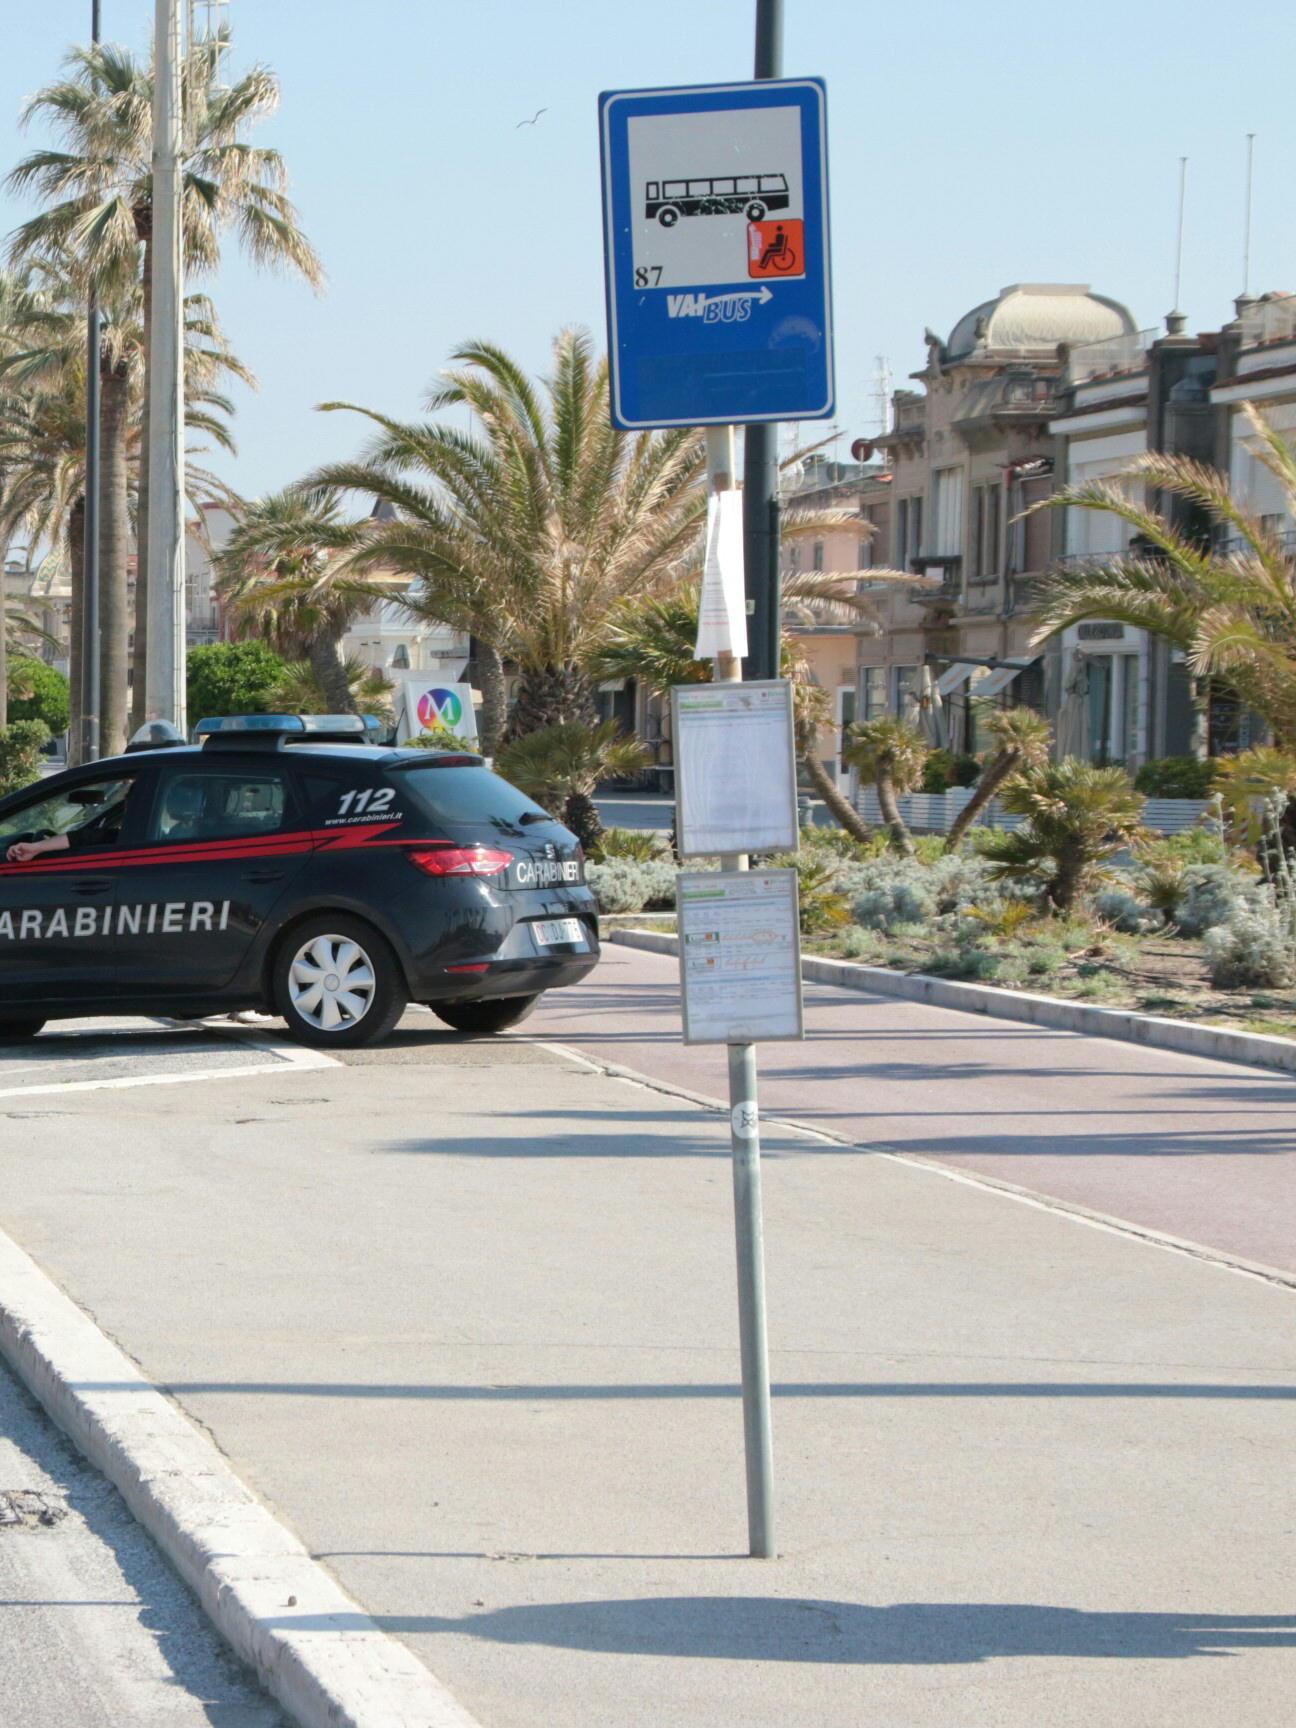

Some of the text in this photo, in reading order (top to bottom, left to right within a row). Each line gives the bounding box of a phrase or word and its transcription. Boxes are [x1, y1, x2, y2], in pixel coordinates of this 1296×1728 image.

[635, 265, 664, 288] 87
[337, 787, 396, 815] 112
[324, 811, 403, 826] www.carabinieri.it
